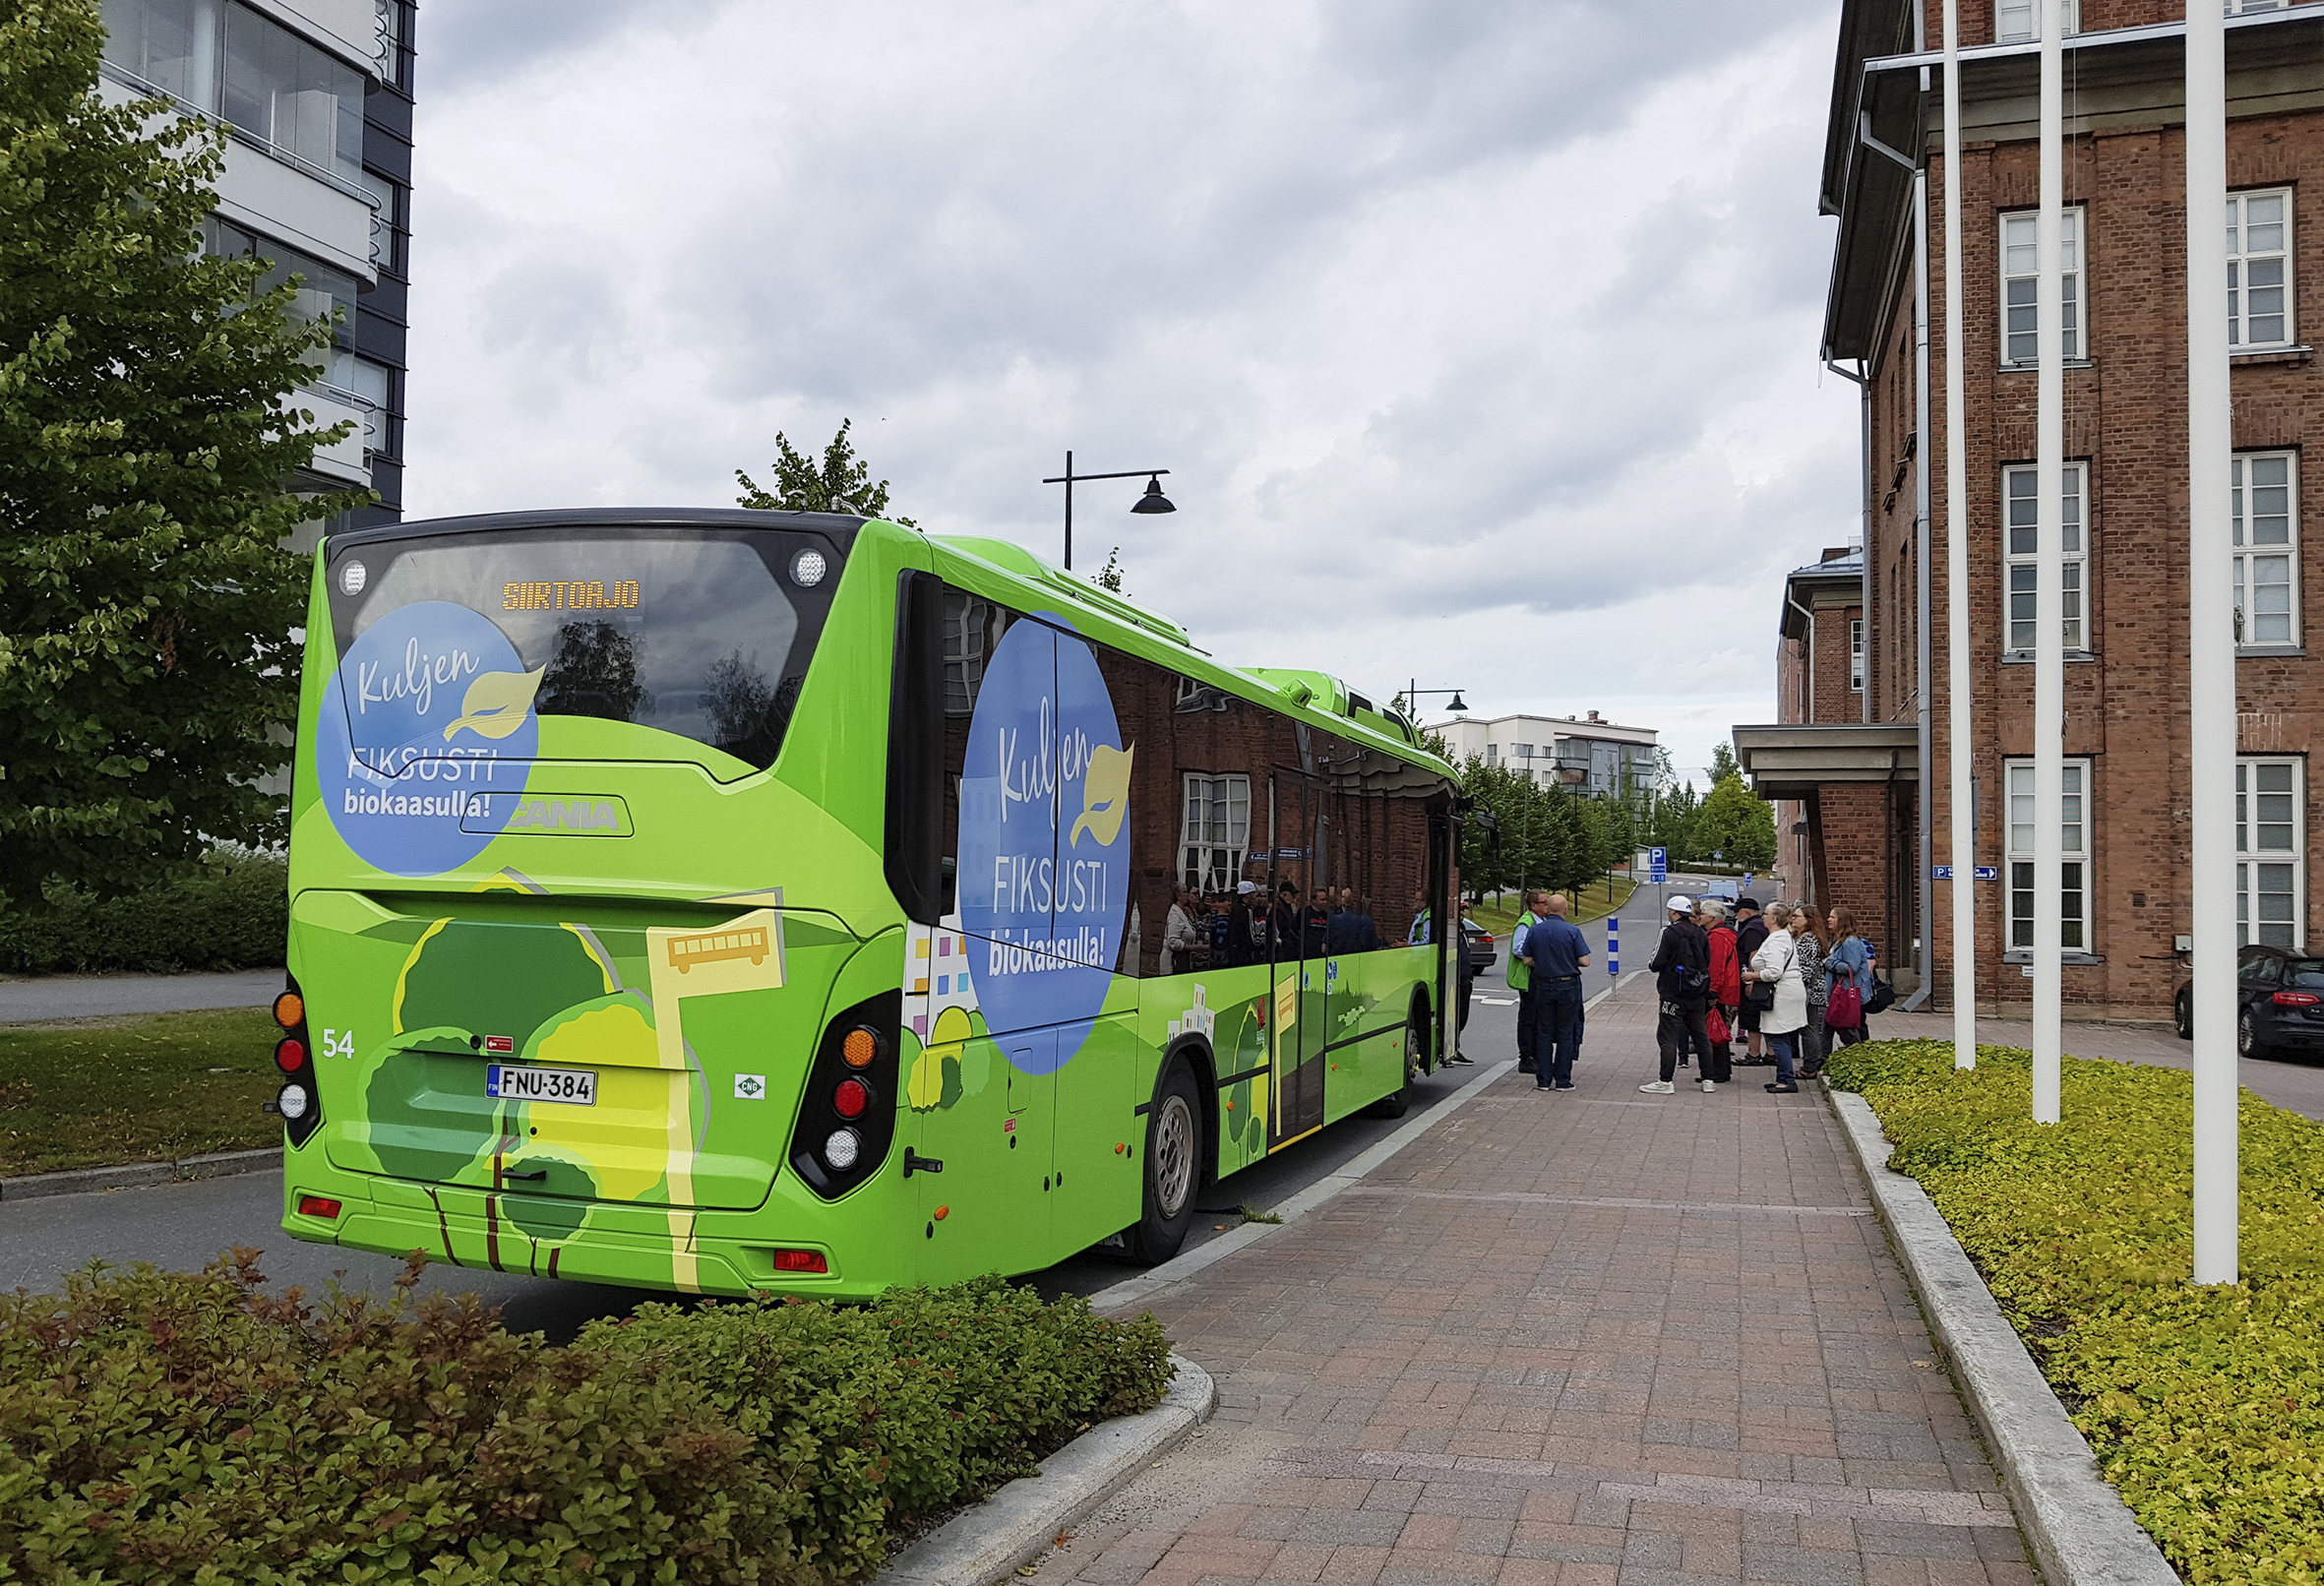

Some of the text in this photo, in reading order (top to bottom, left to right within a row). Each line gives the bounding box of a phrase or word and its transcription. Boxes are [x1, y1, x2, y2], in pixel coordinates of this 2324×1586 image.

[502, 580, 640, 610] SIIRTOAJO
[358, 637, 480, 715] Kuljen
[347, 747, 498, 781] FIKSUSTI
[999, 696, 1094, 830] Kuljen
[343, 787, 491, 818] biokaasulla!
[1652, 849, 1663, 864] P
[993, 856, 1107, 913] FIKSUSTI
[1937, 868, 1944, 877] P
[989, 927, 1105, 976] biokaasulla!
[323, 1028, 355, 1060] 54
[503, 1070, 590, 1100] FNU-384
[741, 1082, 758, 1091] CNG
